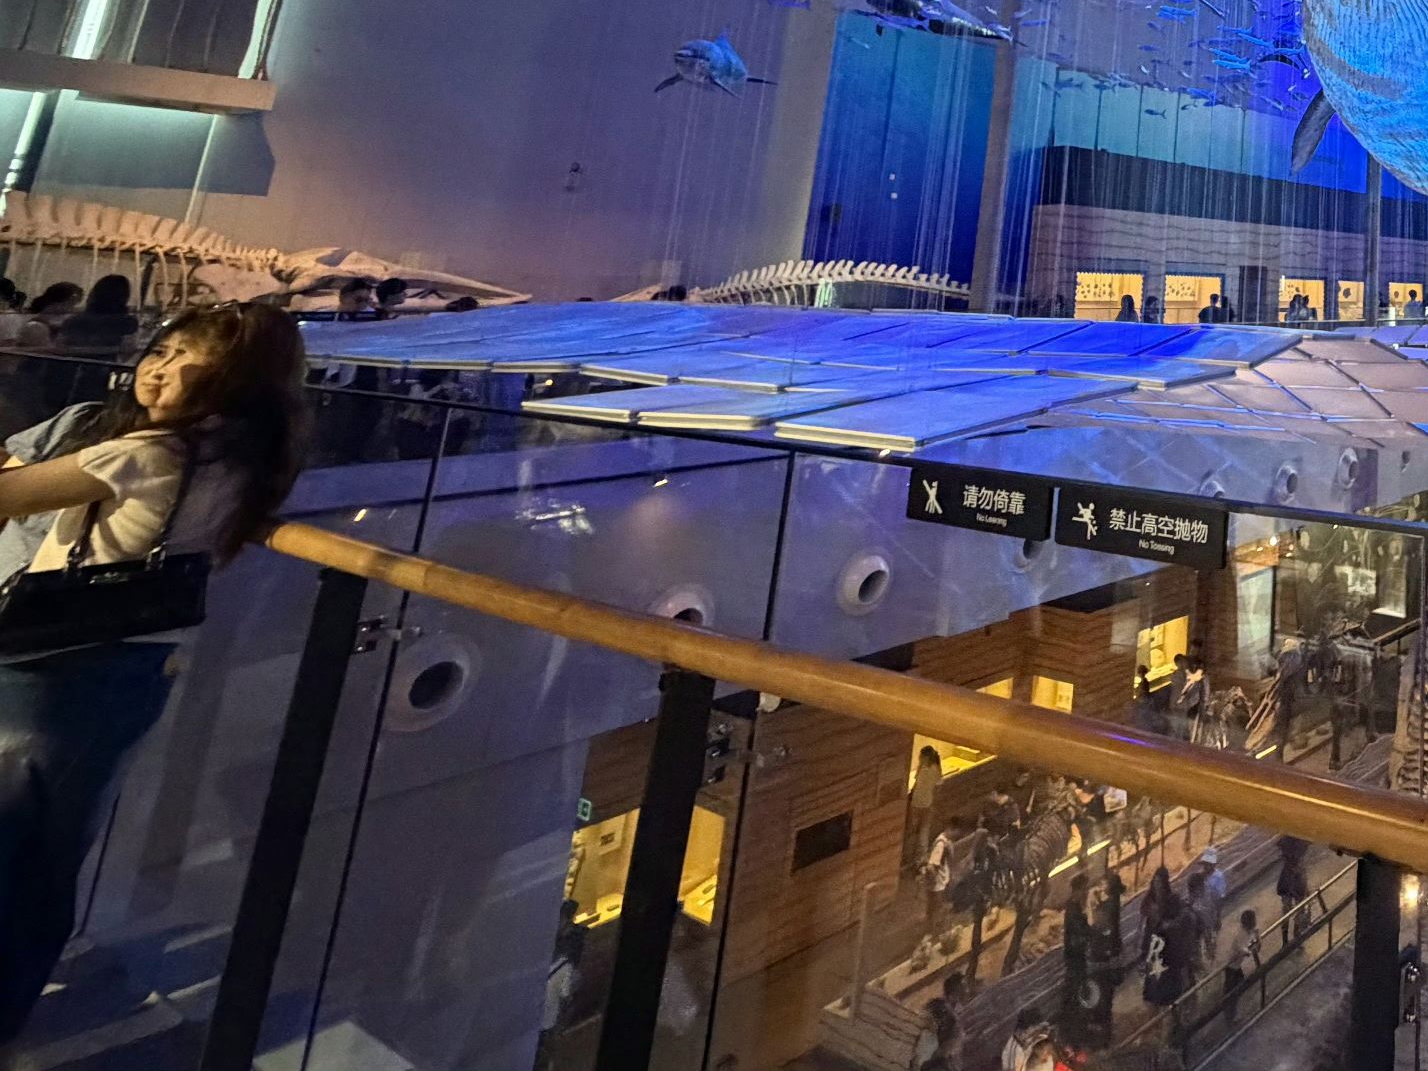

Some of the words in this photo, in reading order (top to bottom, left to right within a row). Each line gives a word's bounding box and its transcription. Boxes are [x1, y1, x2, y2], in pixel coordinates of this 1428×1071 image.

[963, 484, 1026, 515] 请勿倚靠
[1109, 508, 1208, 543] 禁止高空抛物
[1139, 539, 1149, 548] No
